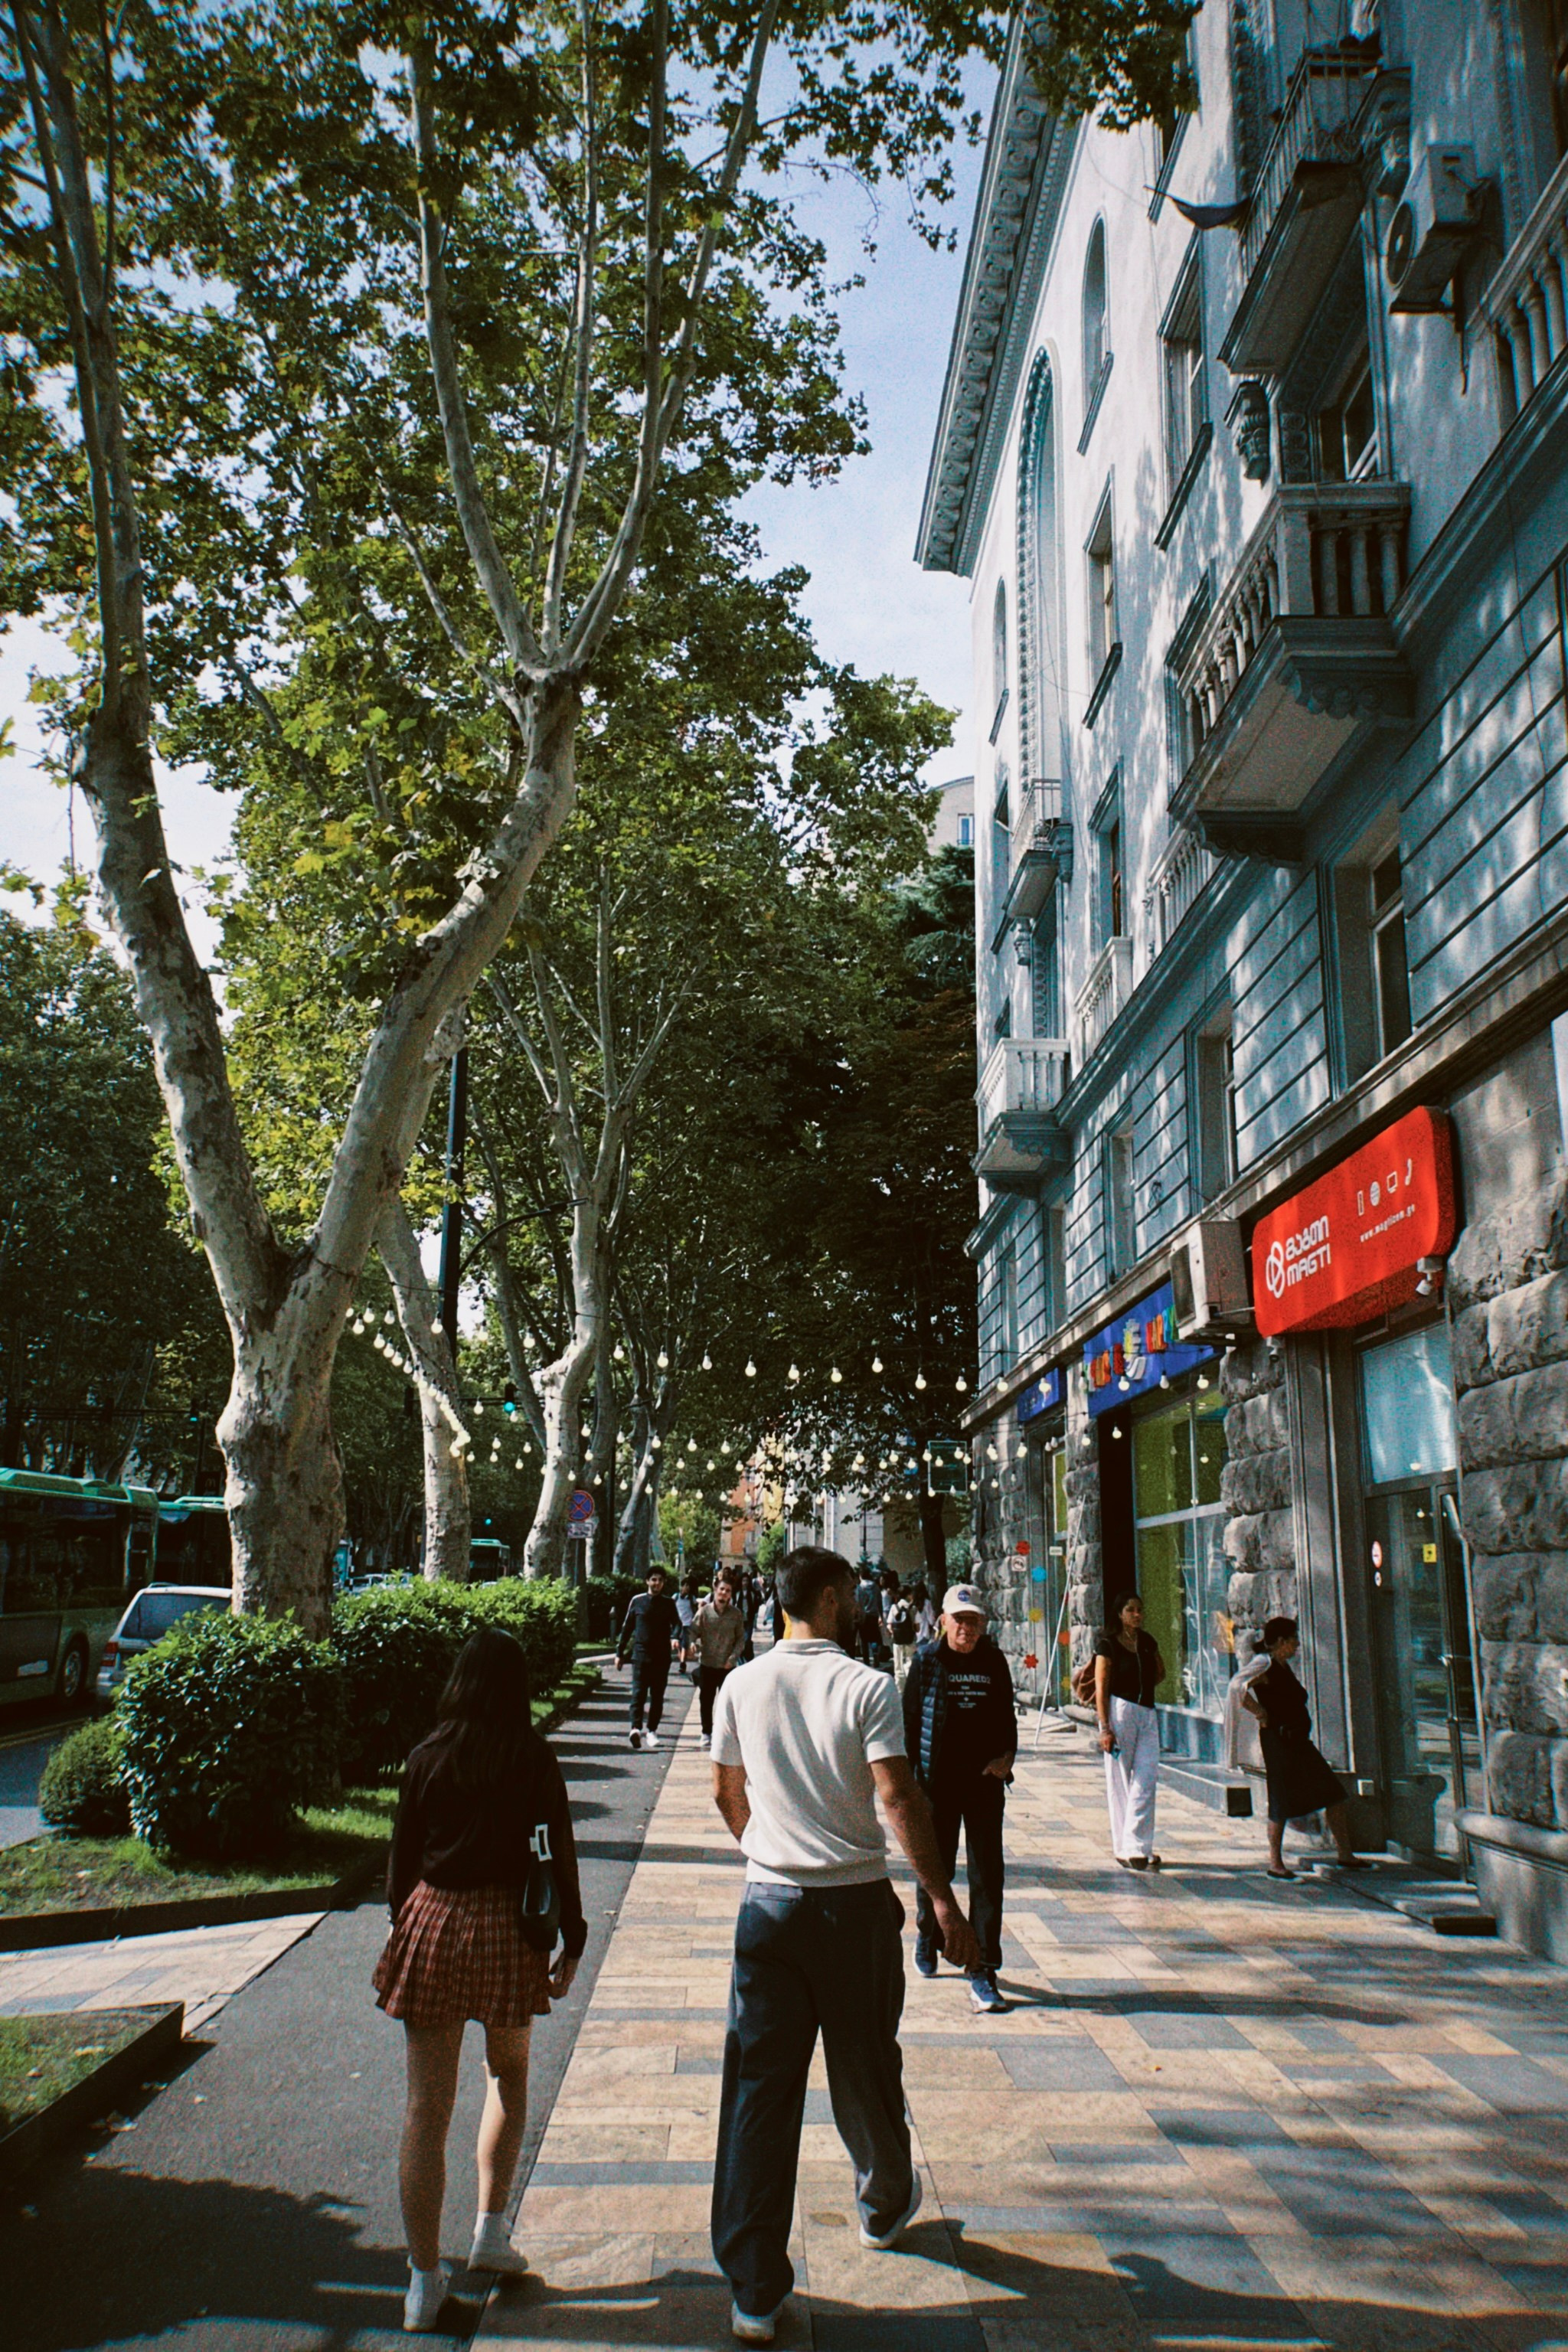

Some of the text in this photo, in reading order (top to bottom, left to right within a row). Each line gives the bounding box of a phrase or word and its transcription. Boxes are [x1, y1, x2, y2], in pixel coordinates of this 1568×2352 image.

[1285, 1215, 1329, 1261] მაგთი
[1287, 1243, 1331, 1286] MAGTI
[948, 1674, 991, 1684] QUARED2
